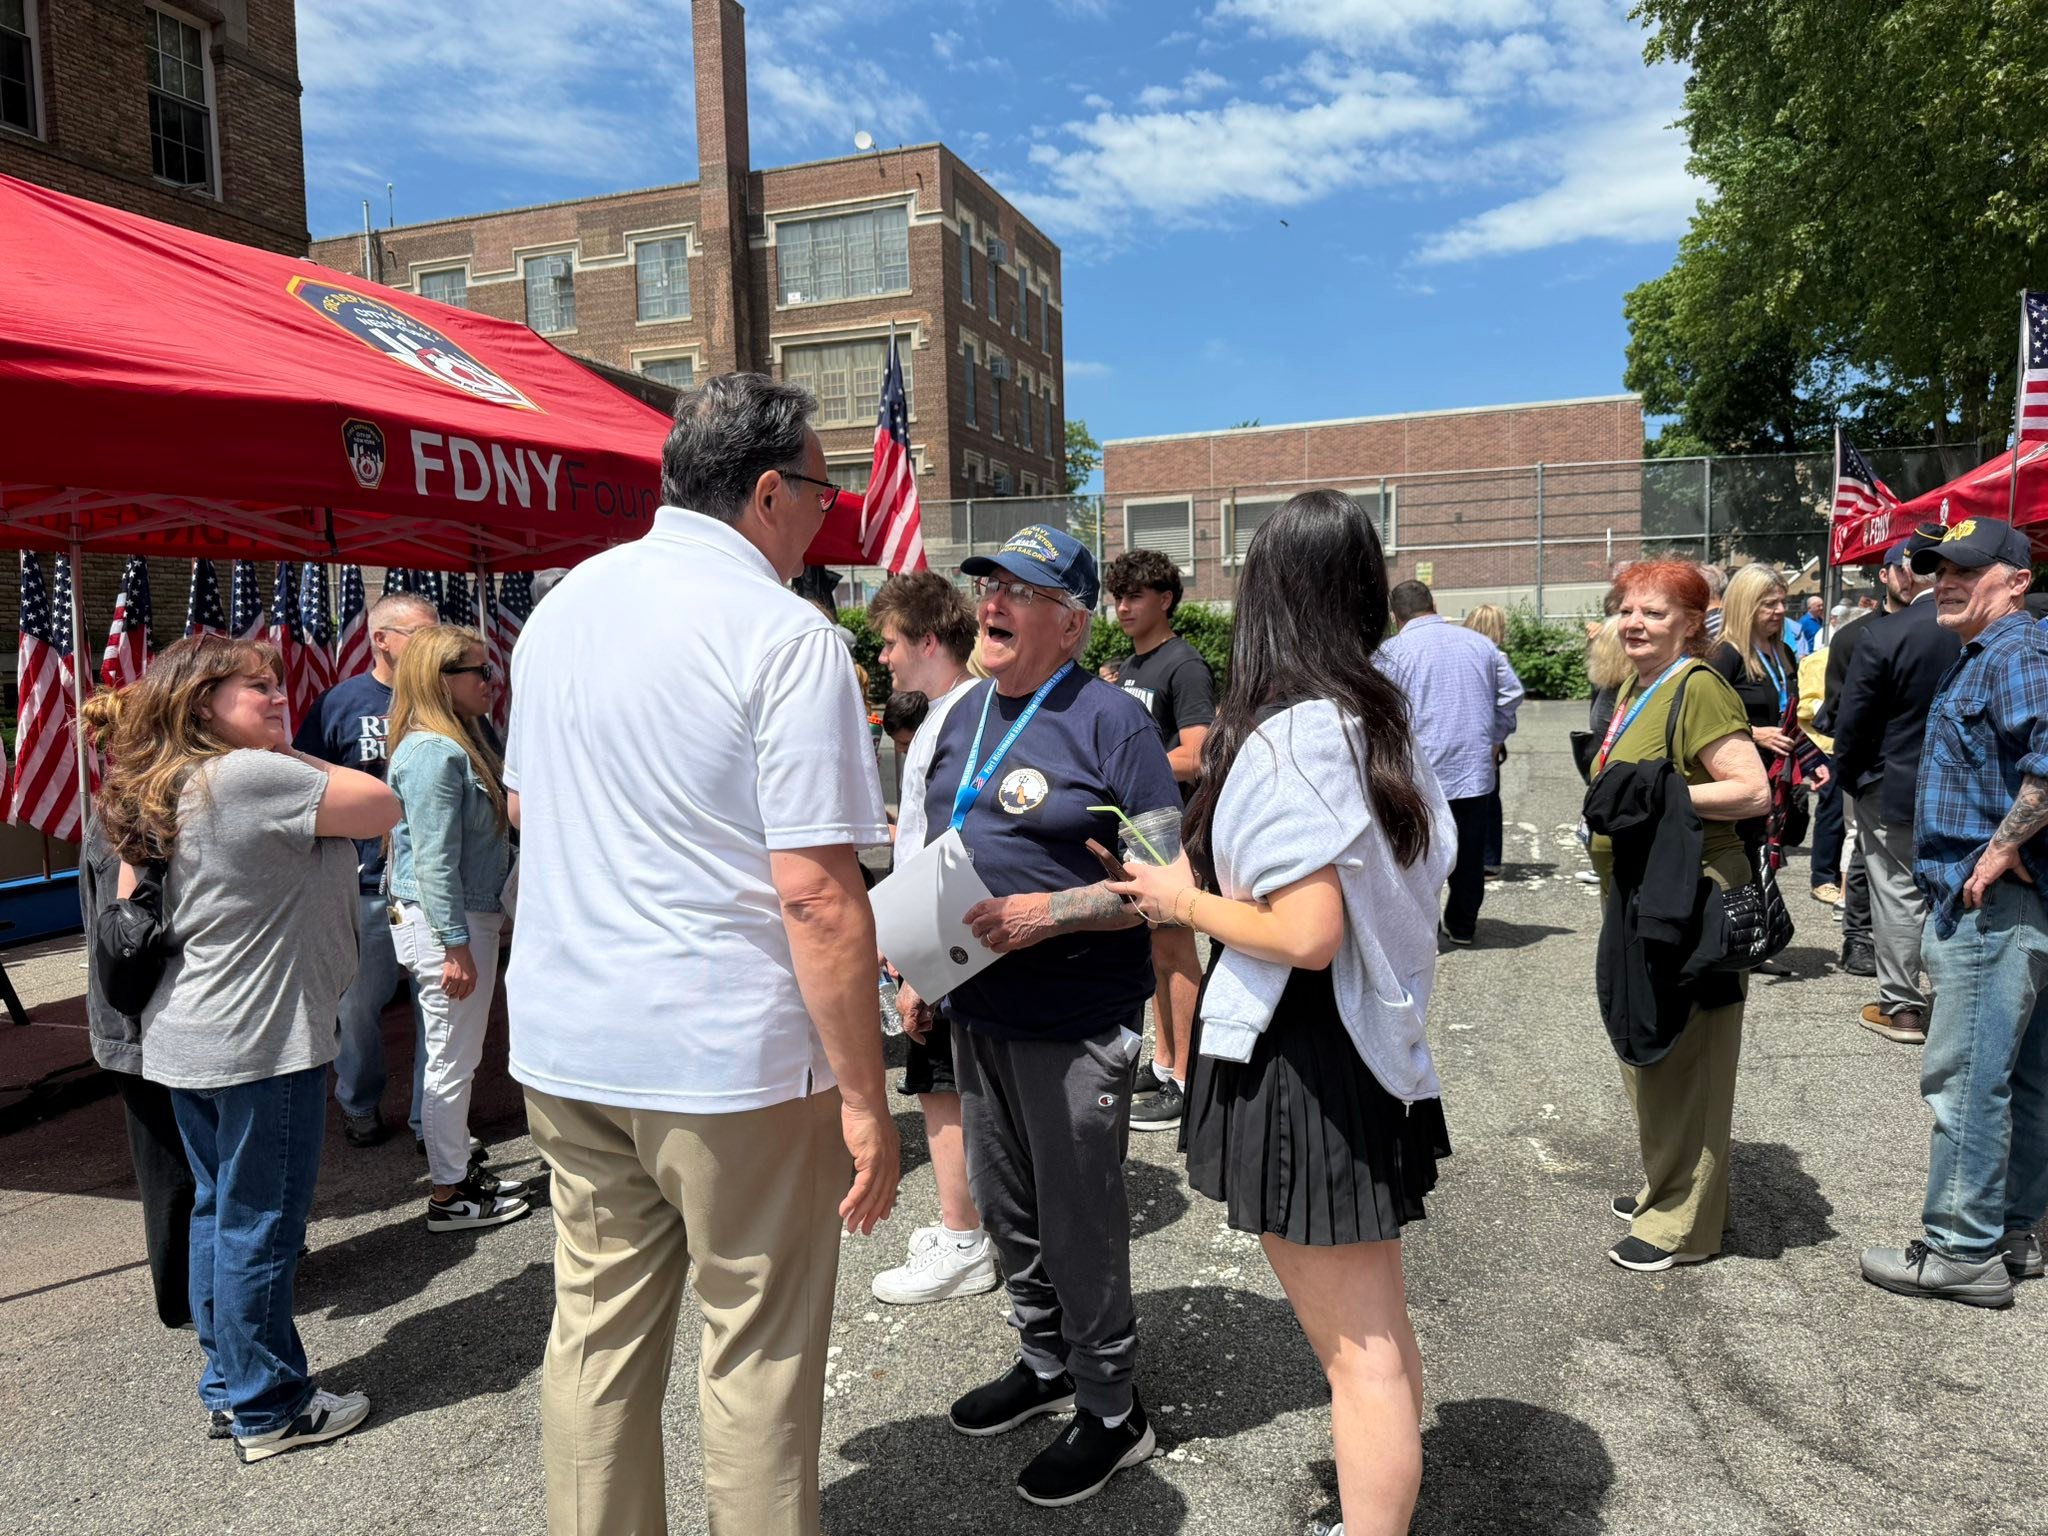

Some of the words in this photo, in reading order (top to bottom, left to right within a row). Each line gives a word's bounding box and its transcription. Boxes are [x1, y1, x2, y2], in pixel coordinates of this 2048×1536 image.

[353, 308, 388, 320] CITY
[356, 316, 395, 330] NEW
[410, 429, 562, 511] FDNY
[1869, 512, 1891, 546] FDNY
[1017, 546, 1047, 562] SAILORS
[1034, 532, 1059, 557] VETERAN
[984, 758, 996, 774] Port
[994, 732, 1016, 762] Richmond
[1013, 714, 1029, 734] Staten
